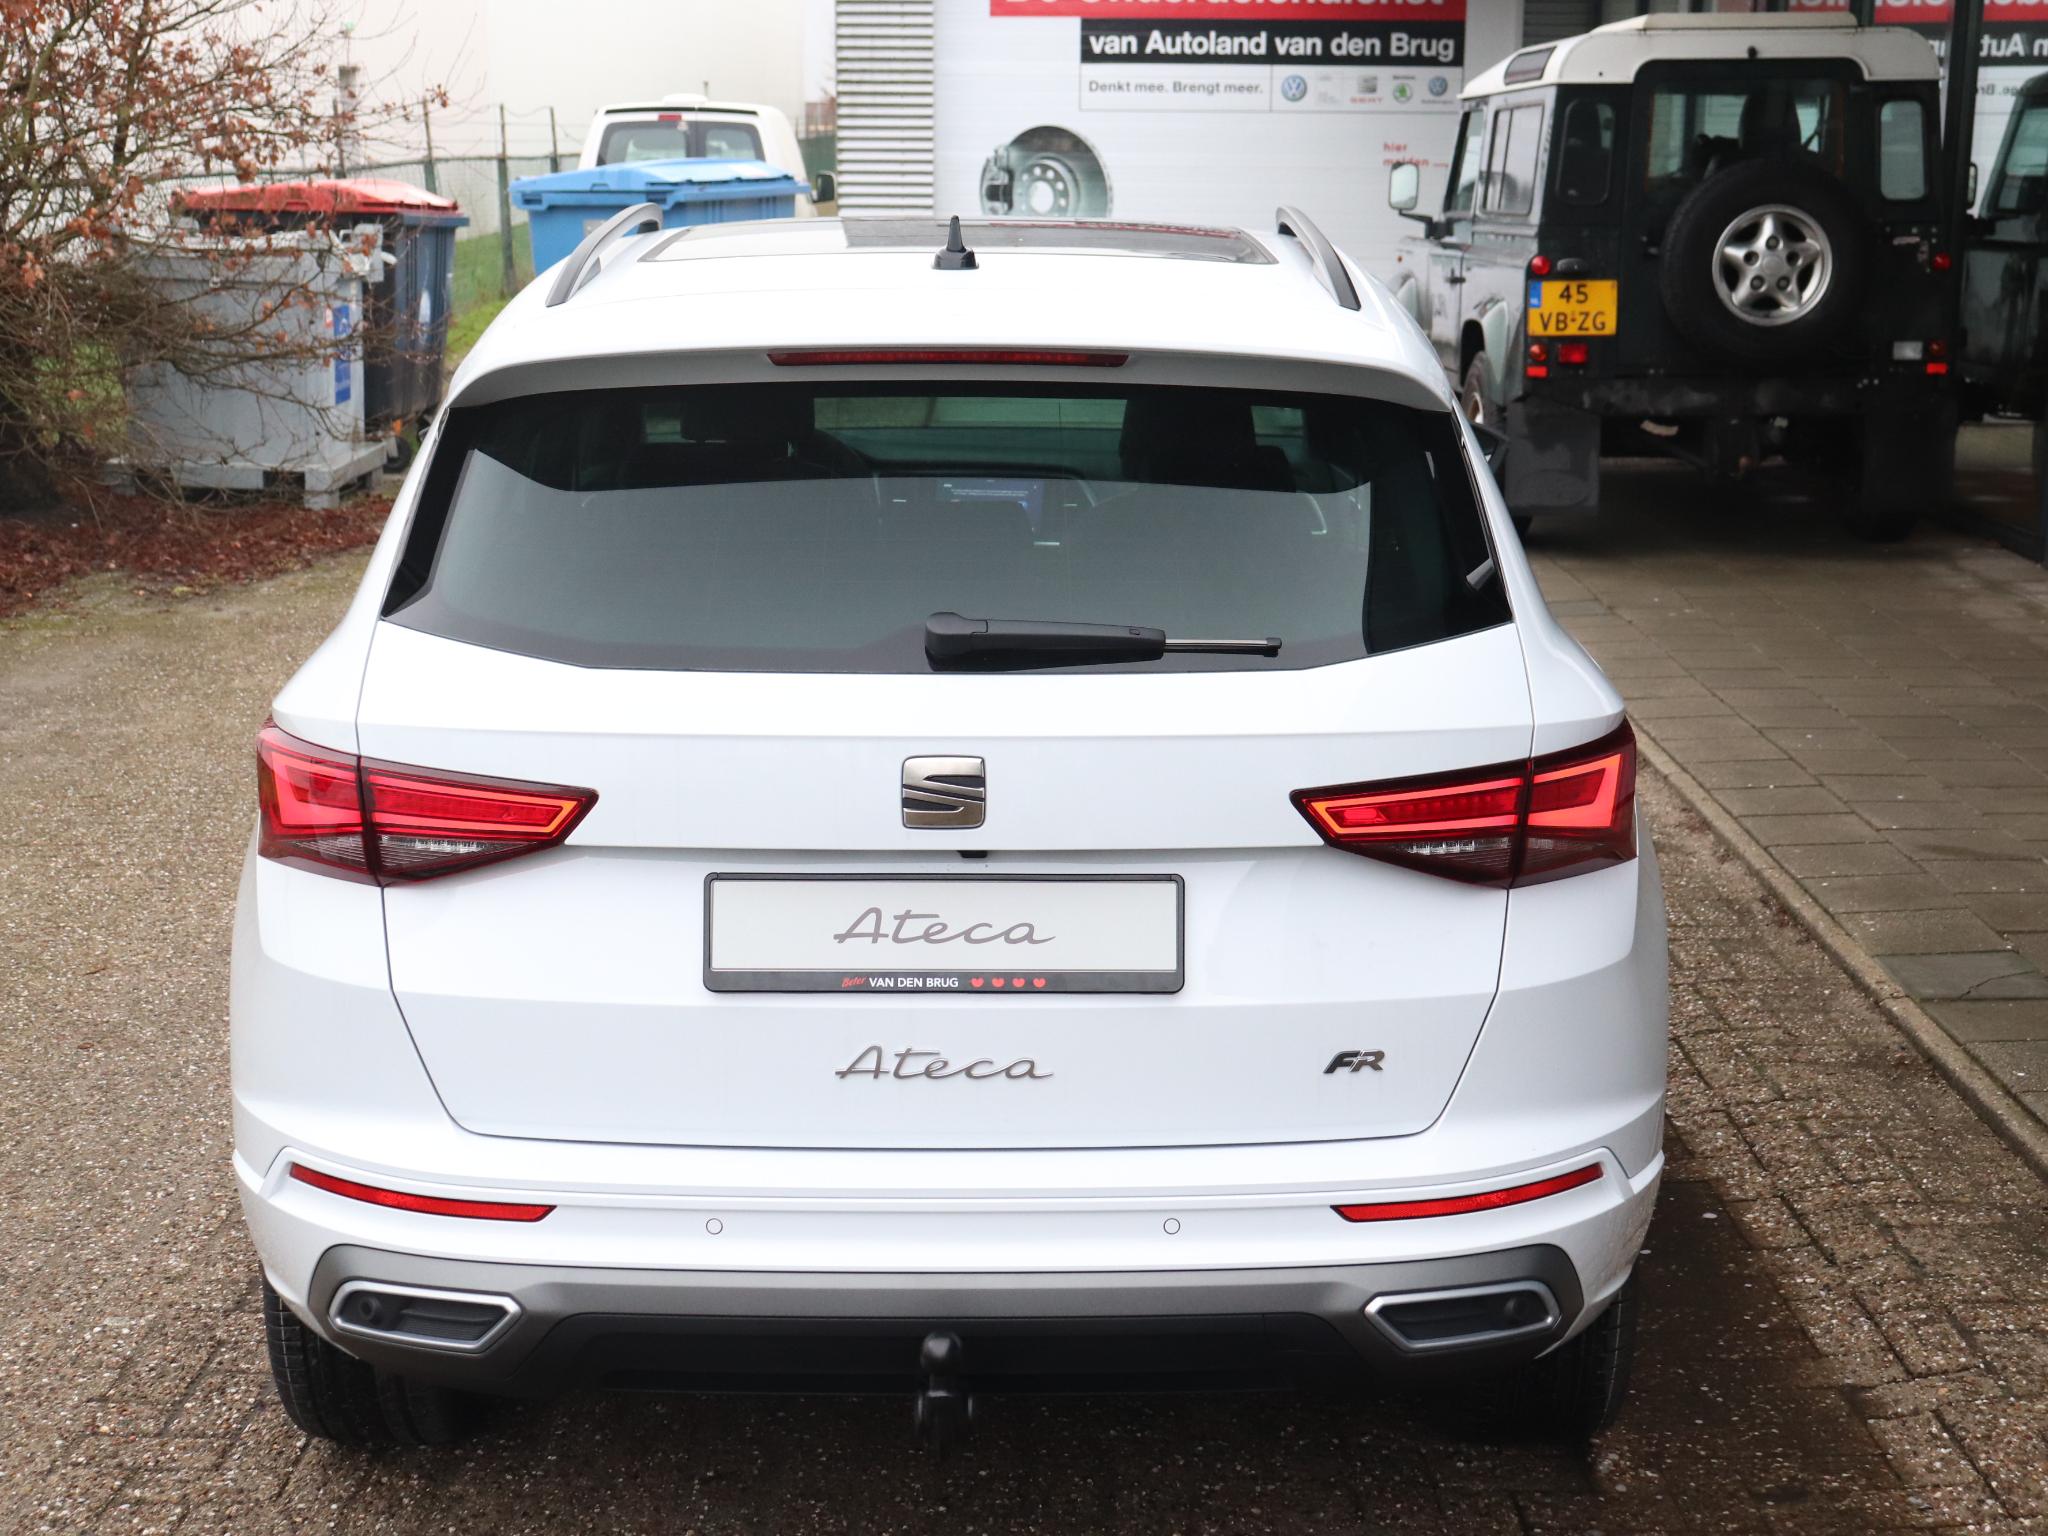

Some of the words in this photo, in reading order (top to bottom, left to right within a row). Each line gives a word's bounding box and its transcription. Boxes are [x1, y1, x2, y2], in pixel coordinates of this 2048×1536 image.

[1089, 35, 1138, 55] van
[1145, 30, 1267, 56] Autoland
[1274, 36, 1323, 56] van
[1330, 32, 1381, 56] den
[1389, 32, 1455, 62] Brug
[1088, 80, 1131, 93] Denkt
[1134, 82, 1168, 93] mee.
[1173, 81, 1220, 96] Brengt
[1224, 82, 1264, 95] meer.
[1558, 283, 1589, 304] 45
[833, 907, 1056, 944] Ateca
[869, 977, 894, 988] VAN
[897, 977, 923, 988] DEN
[926, 977, 959, 988] BRUG
[835, 1045, 1054, 1080] Ateca
[1323, 1050, 1386, 1074] FR
